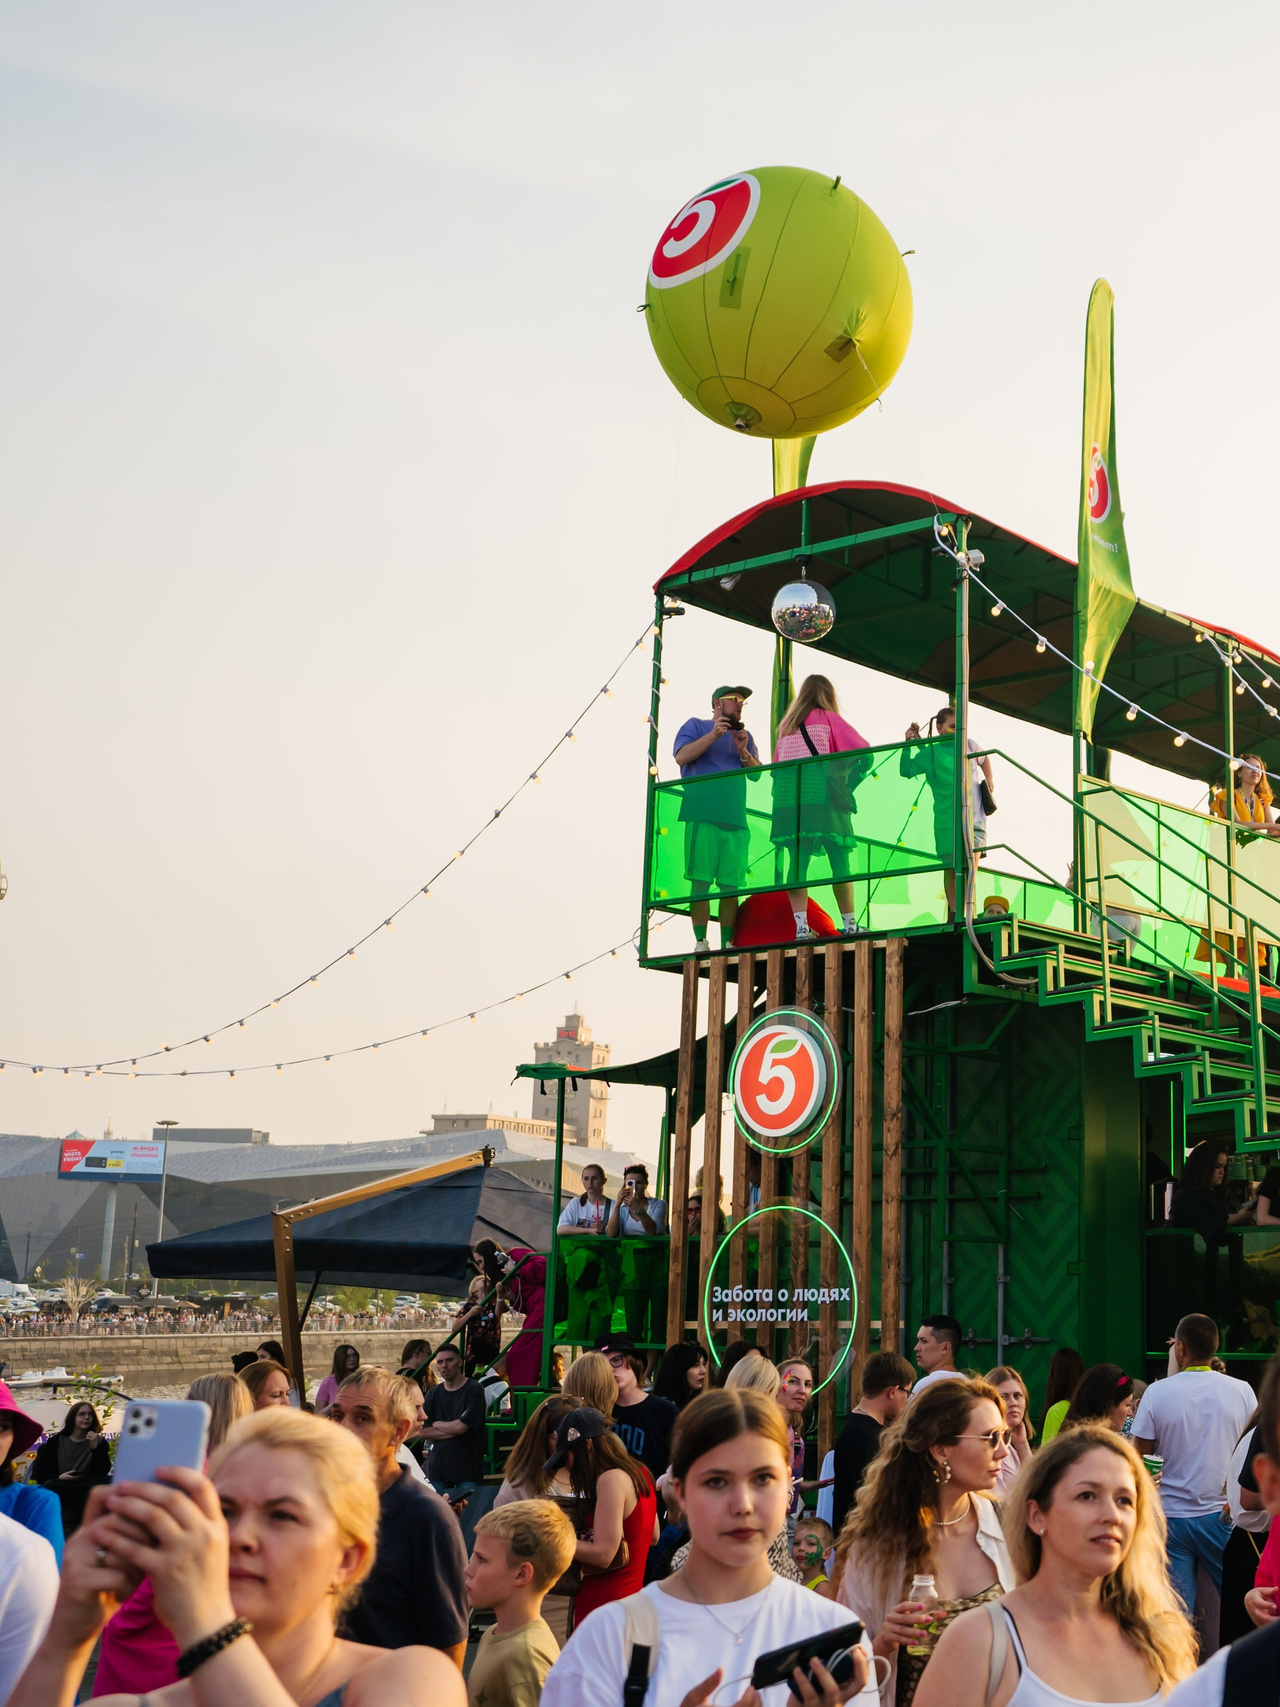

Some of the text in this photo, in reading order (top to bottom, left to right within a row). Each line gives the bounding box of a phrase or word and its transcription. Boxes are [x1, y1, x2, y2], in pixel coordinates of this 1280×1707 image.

[755, 1034, 801, 1116] 5
[712, 1284, 851, 1304] Забота о людях
[712, 1308, 808, 1322] и экологии
